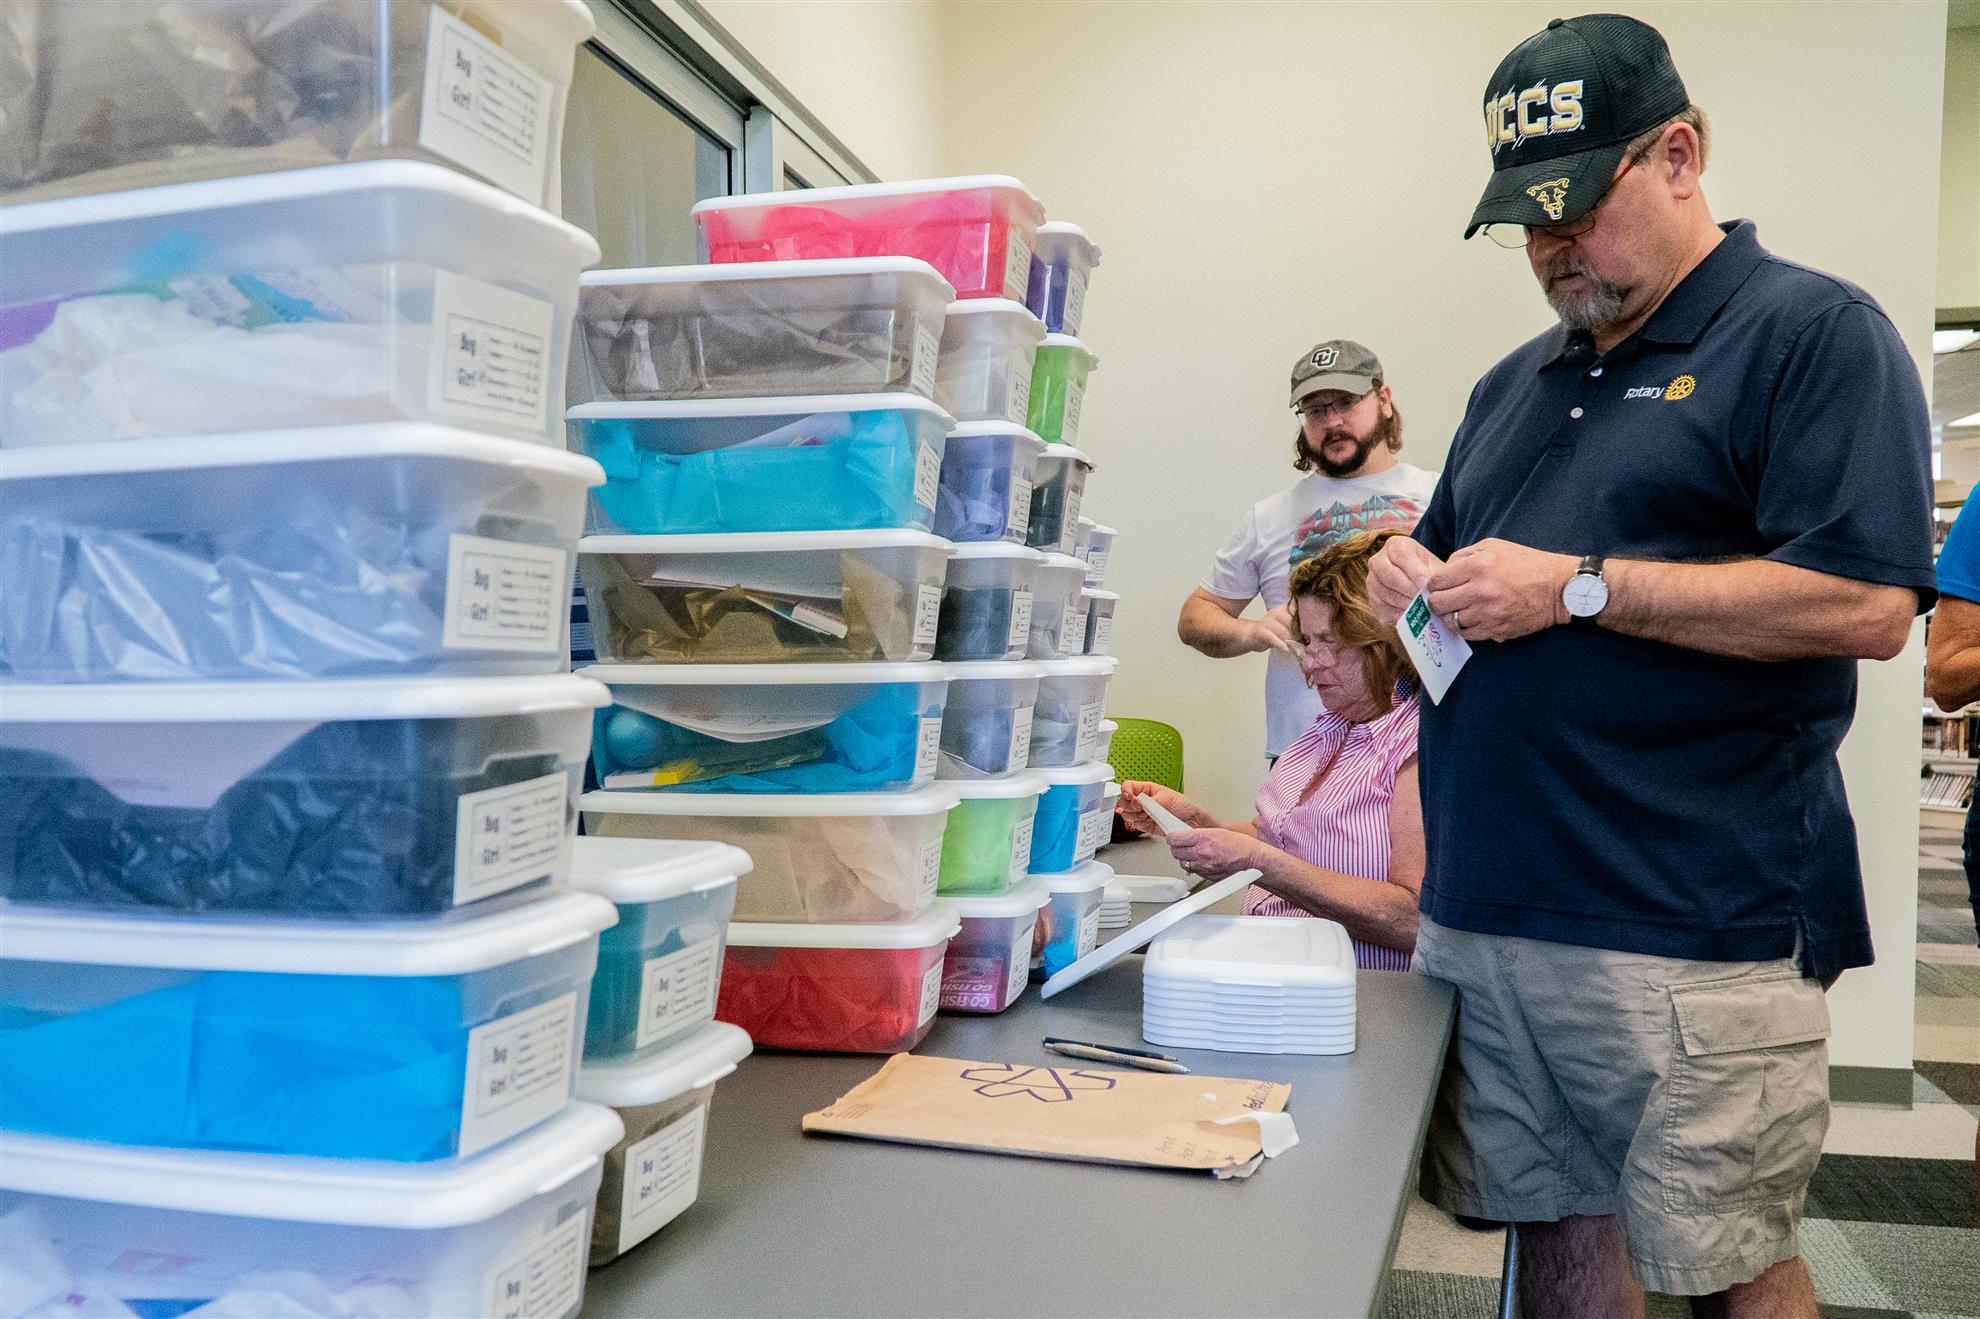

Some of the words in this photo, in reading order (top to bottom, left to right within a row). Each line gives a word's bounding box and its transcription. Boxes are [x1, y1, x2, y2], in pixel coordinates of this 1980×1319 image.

[1311, 346, 1340, 369] CU
[1623, 386, 1665, 400] Rotary
[970, 995, 990, 1007] GO
